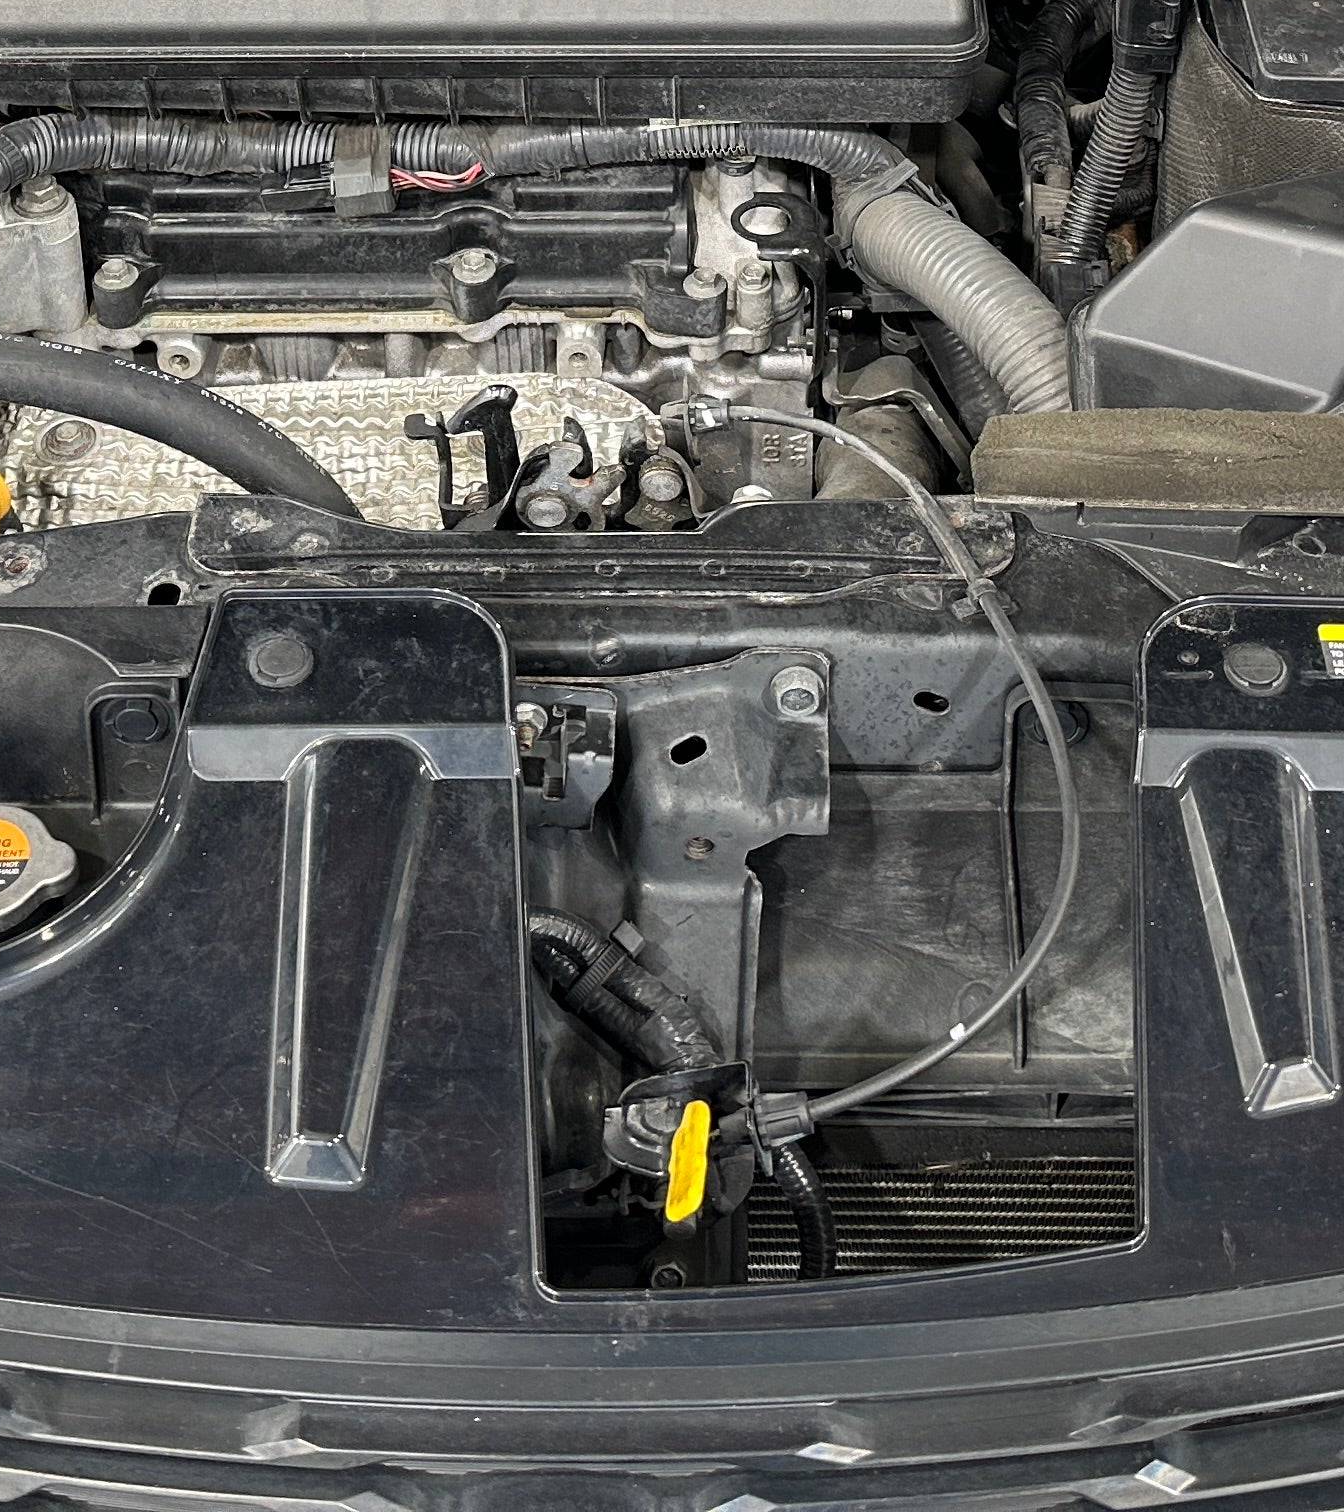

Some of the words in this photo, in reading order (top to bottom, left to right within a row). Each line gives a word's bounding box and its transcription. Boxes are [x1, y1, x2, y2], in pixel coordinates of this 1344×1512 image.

[39, 340, 83, 355] HOSE
[114, 358, 185, 385] GALAXY
[1330, 650, 1344, 658] TO
[1332, 659, 1344, 668] LE
